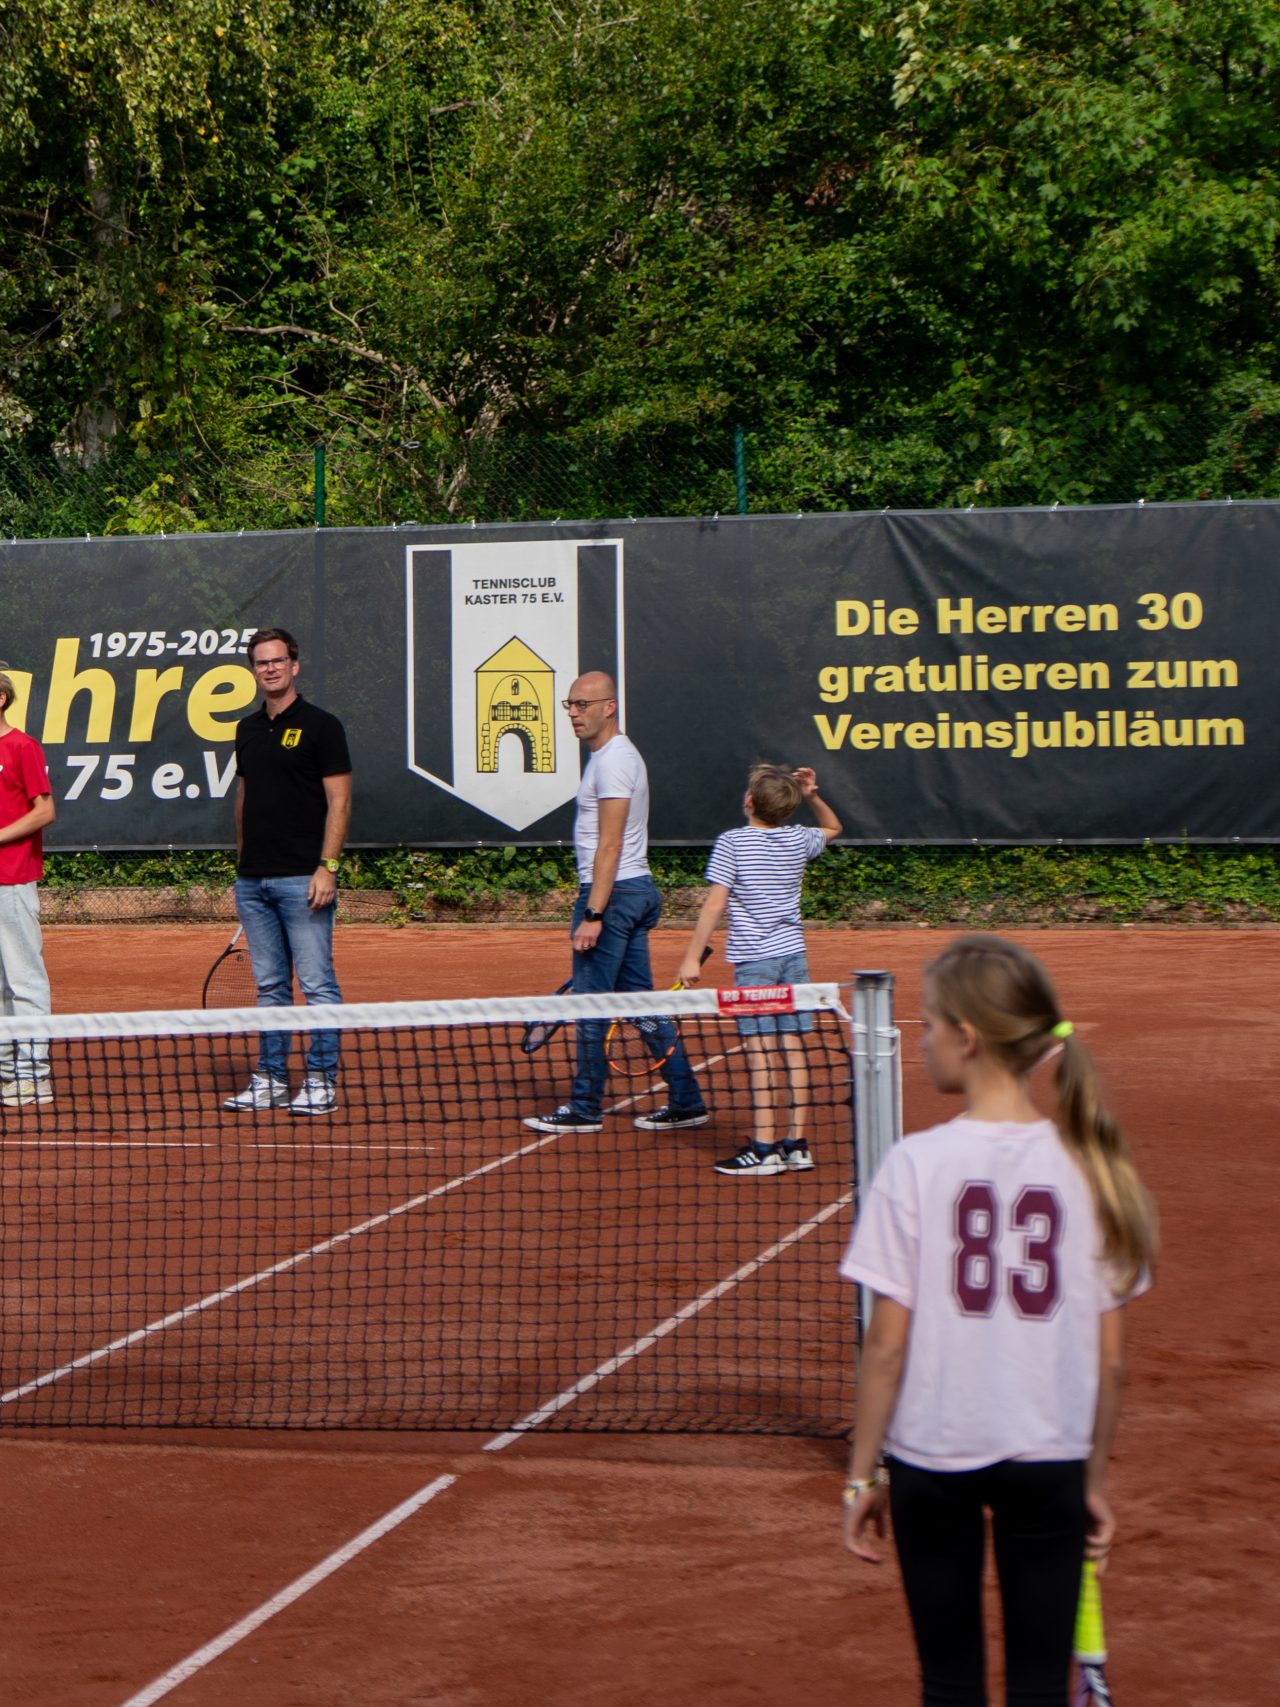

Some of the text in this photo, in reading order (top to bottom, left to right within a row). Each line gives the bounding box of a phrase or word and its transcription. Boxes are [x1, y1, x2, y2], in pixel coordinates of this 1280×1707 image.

[465, 592, 564, 605] KASTER 75 E.V.
[472, 577, 556, 589] TENNISCLUB
[835, 592, 1203, 636] Die Herren 30
[90, 628, 258, 658] 1975-2025
[818, 655, 1238, 703] gratulieren zum
[813, 710, 1245, 758] Vereinsjubiläum
[64, 754, 136, 800] 75
[742, 987, 789, 1000] TENNIS
[953, 1179, 1067, 1322] 83
